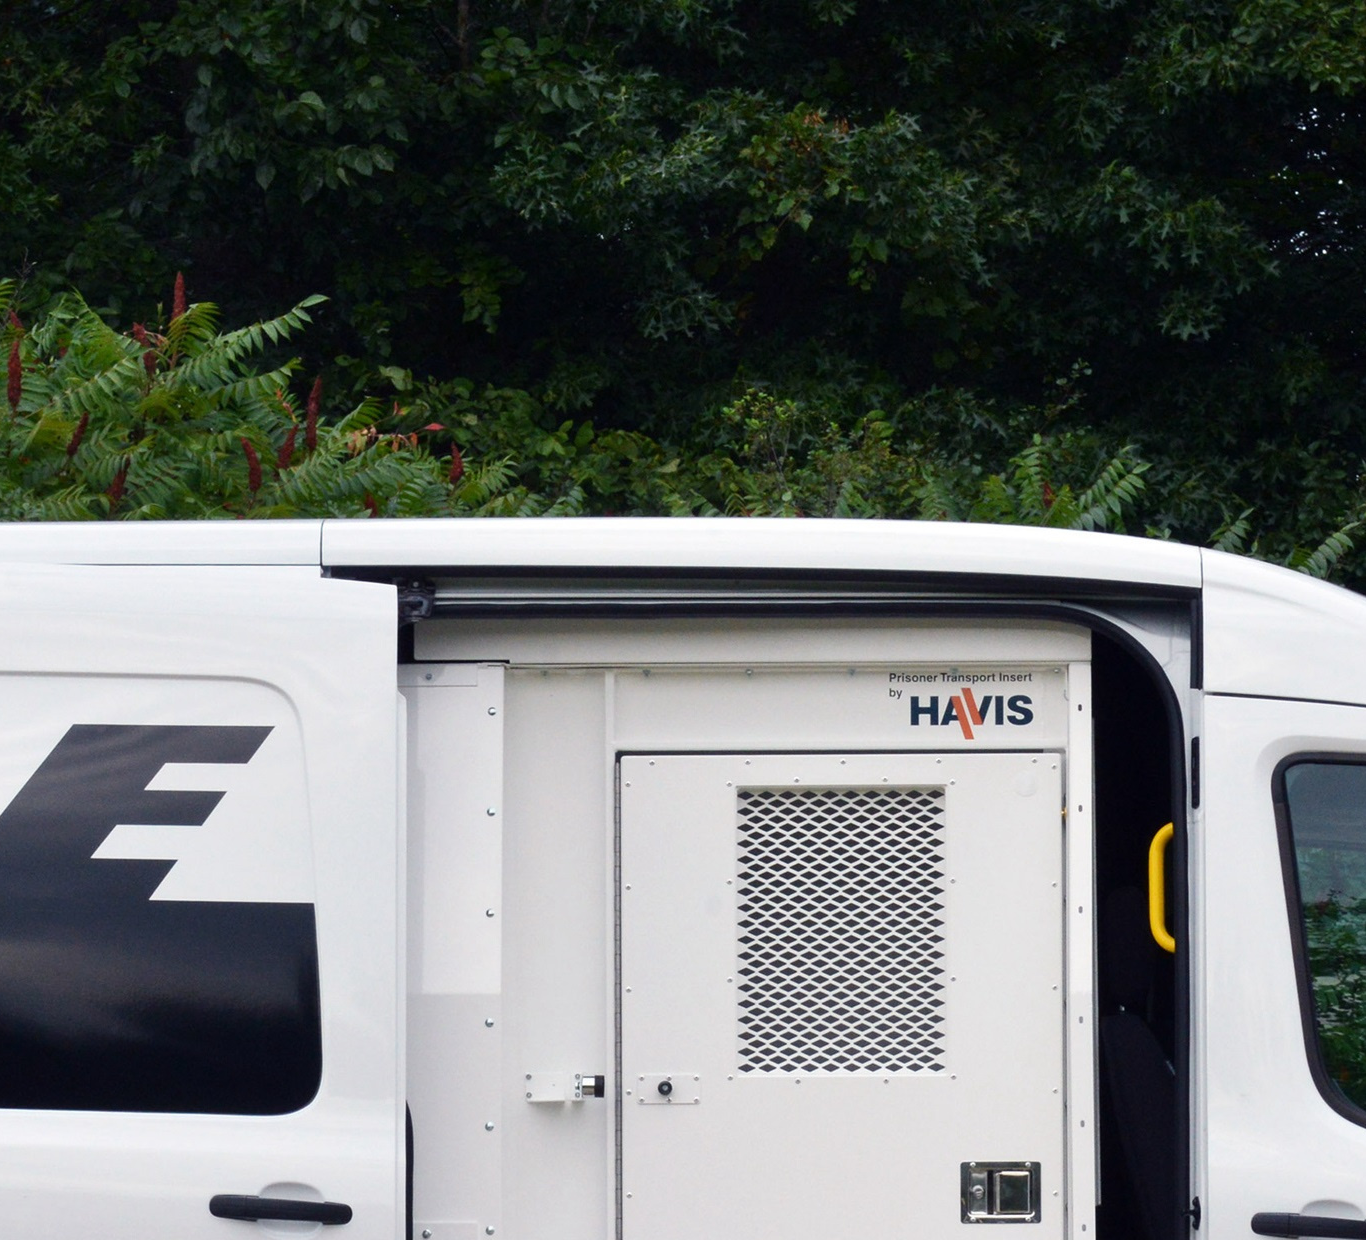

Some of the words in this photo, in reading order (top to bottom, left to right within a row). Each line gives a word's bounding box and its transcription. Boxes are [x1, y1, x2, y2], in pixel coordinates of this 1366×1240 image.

[888, 672, 938, 683] Prisoner
[940, 672, 996, 685] Transport
[999, 672, 1033, 683] Insert
[888, 687, 903, 699] by
[909, 687, 1034, 740] HAVIS
